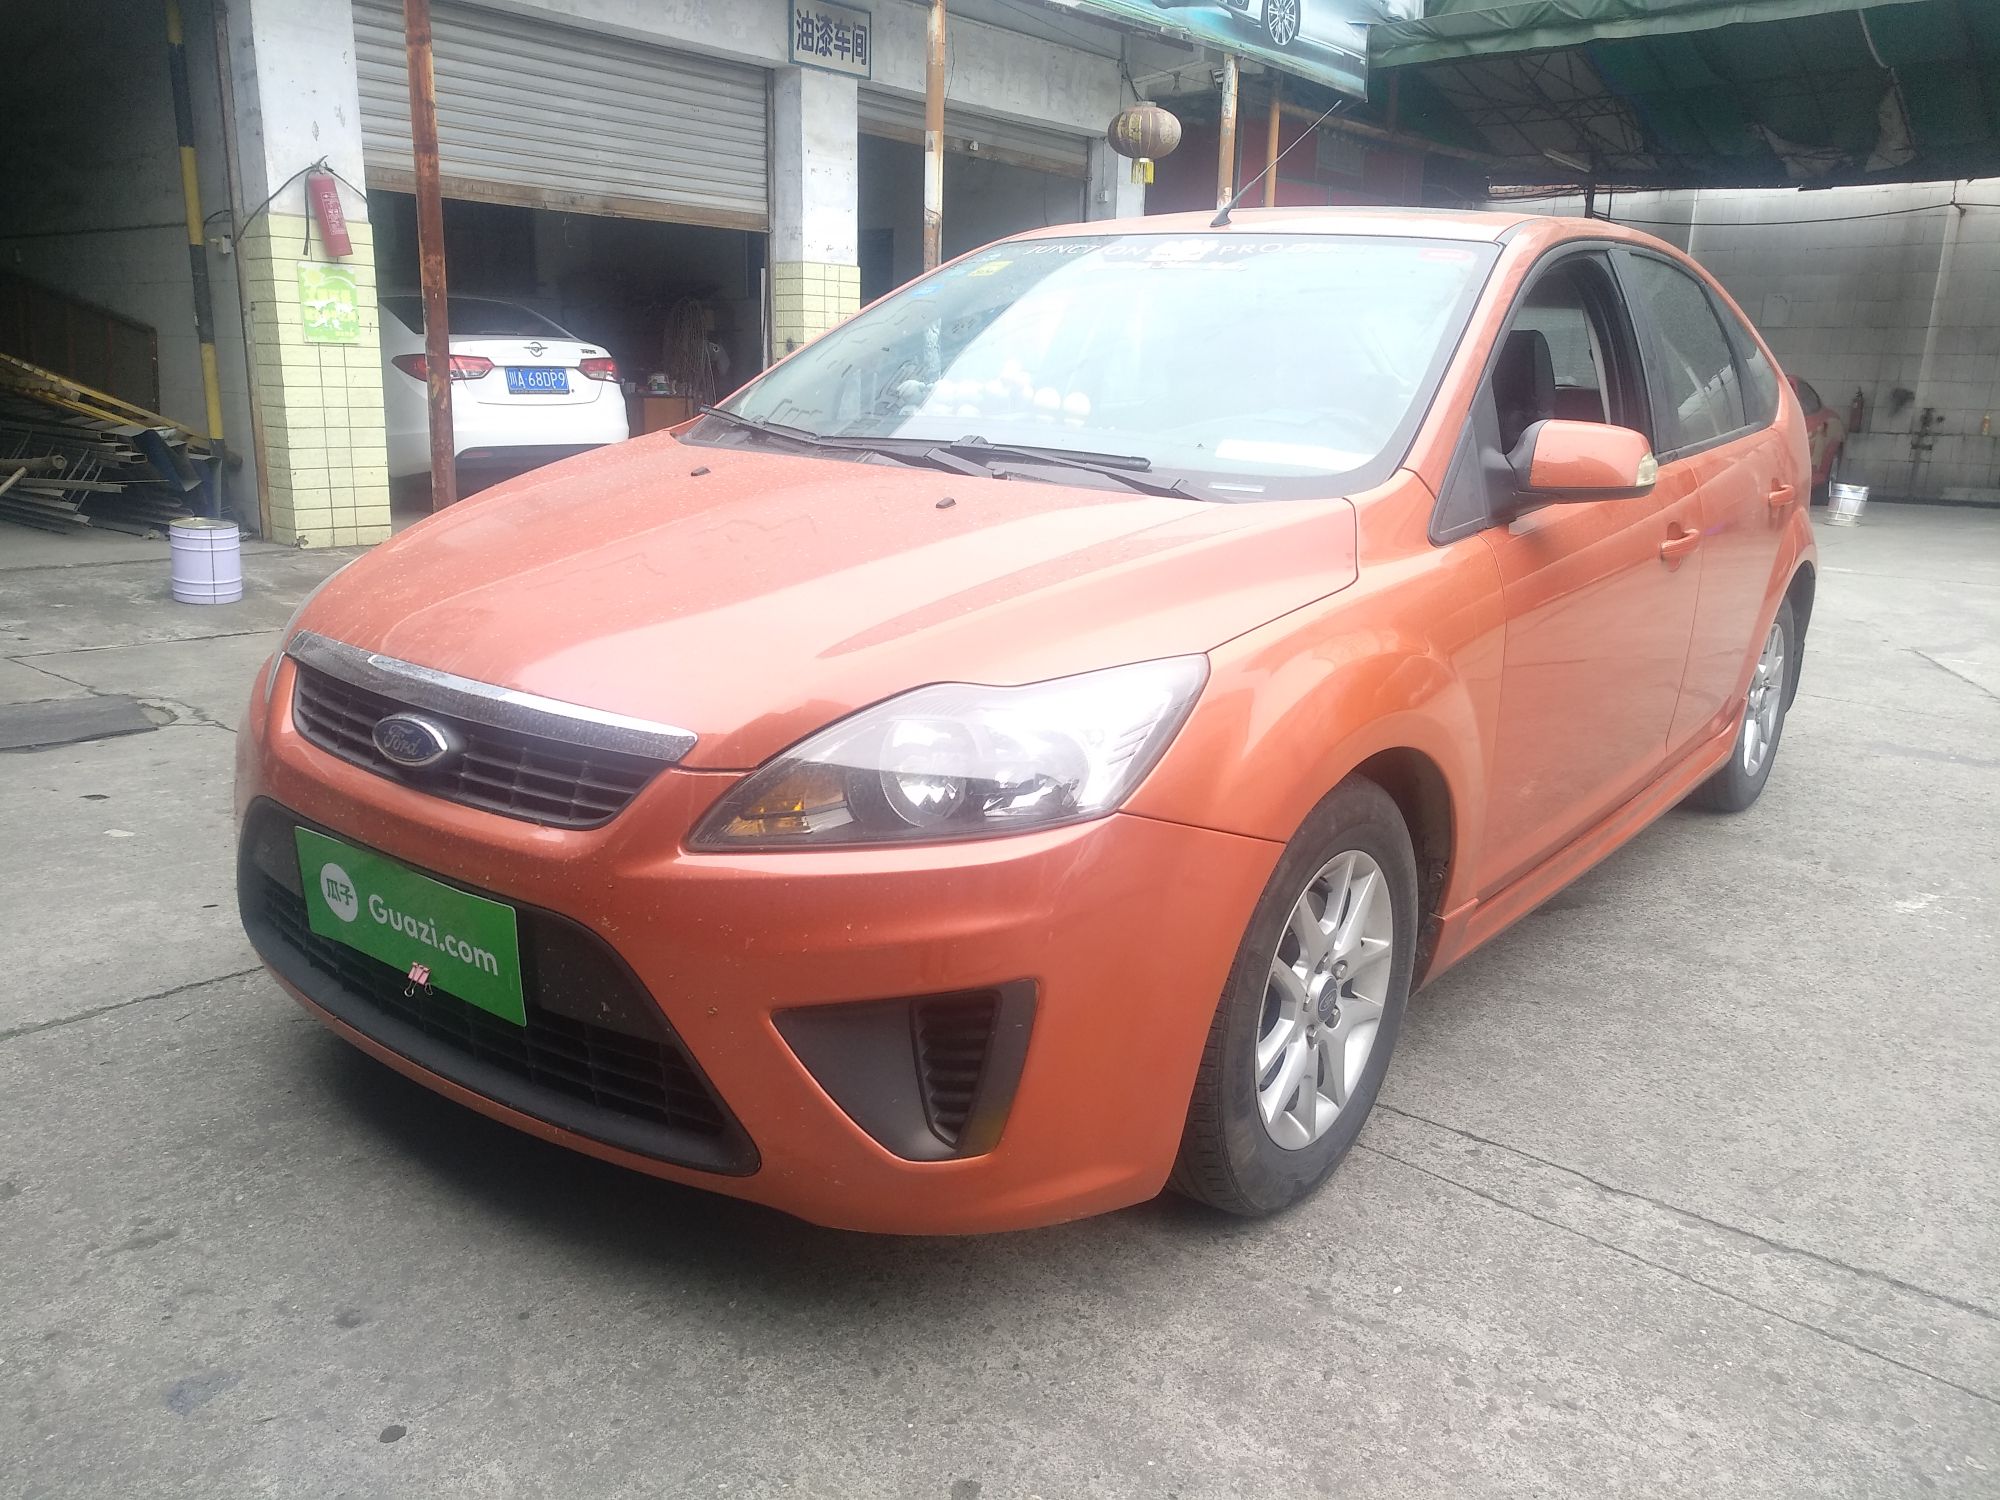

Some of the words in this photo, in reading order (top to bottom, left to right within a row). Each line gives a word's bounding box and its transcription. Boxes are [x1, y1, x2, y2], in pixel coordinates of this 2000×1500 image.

[796, 8, 867, 65] 油漆车间
[383, 725, 422, 756] Ford
[326, 877, 353, 906] 瓜子
[368, 894, 499, 976] Guazi.com
